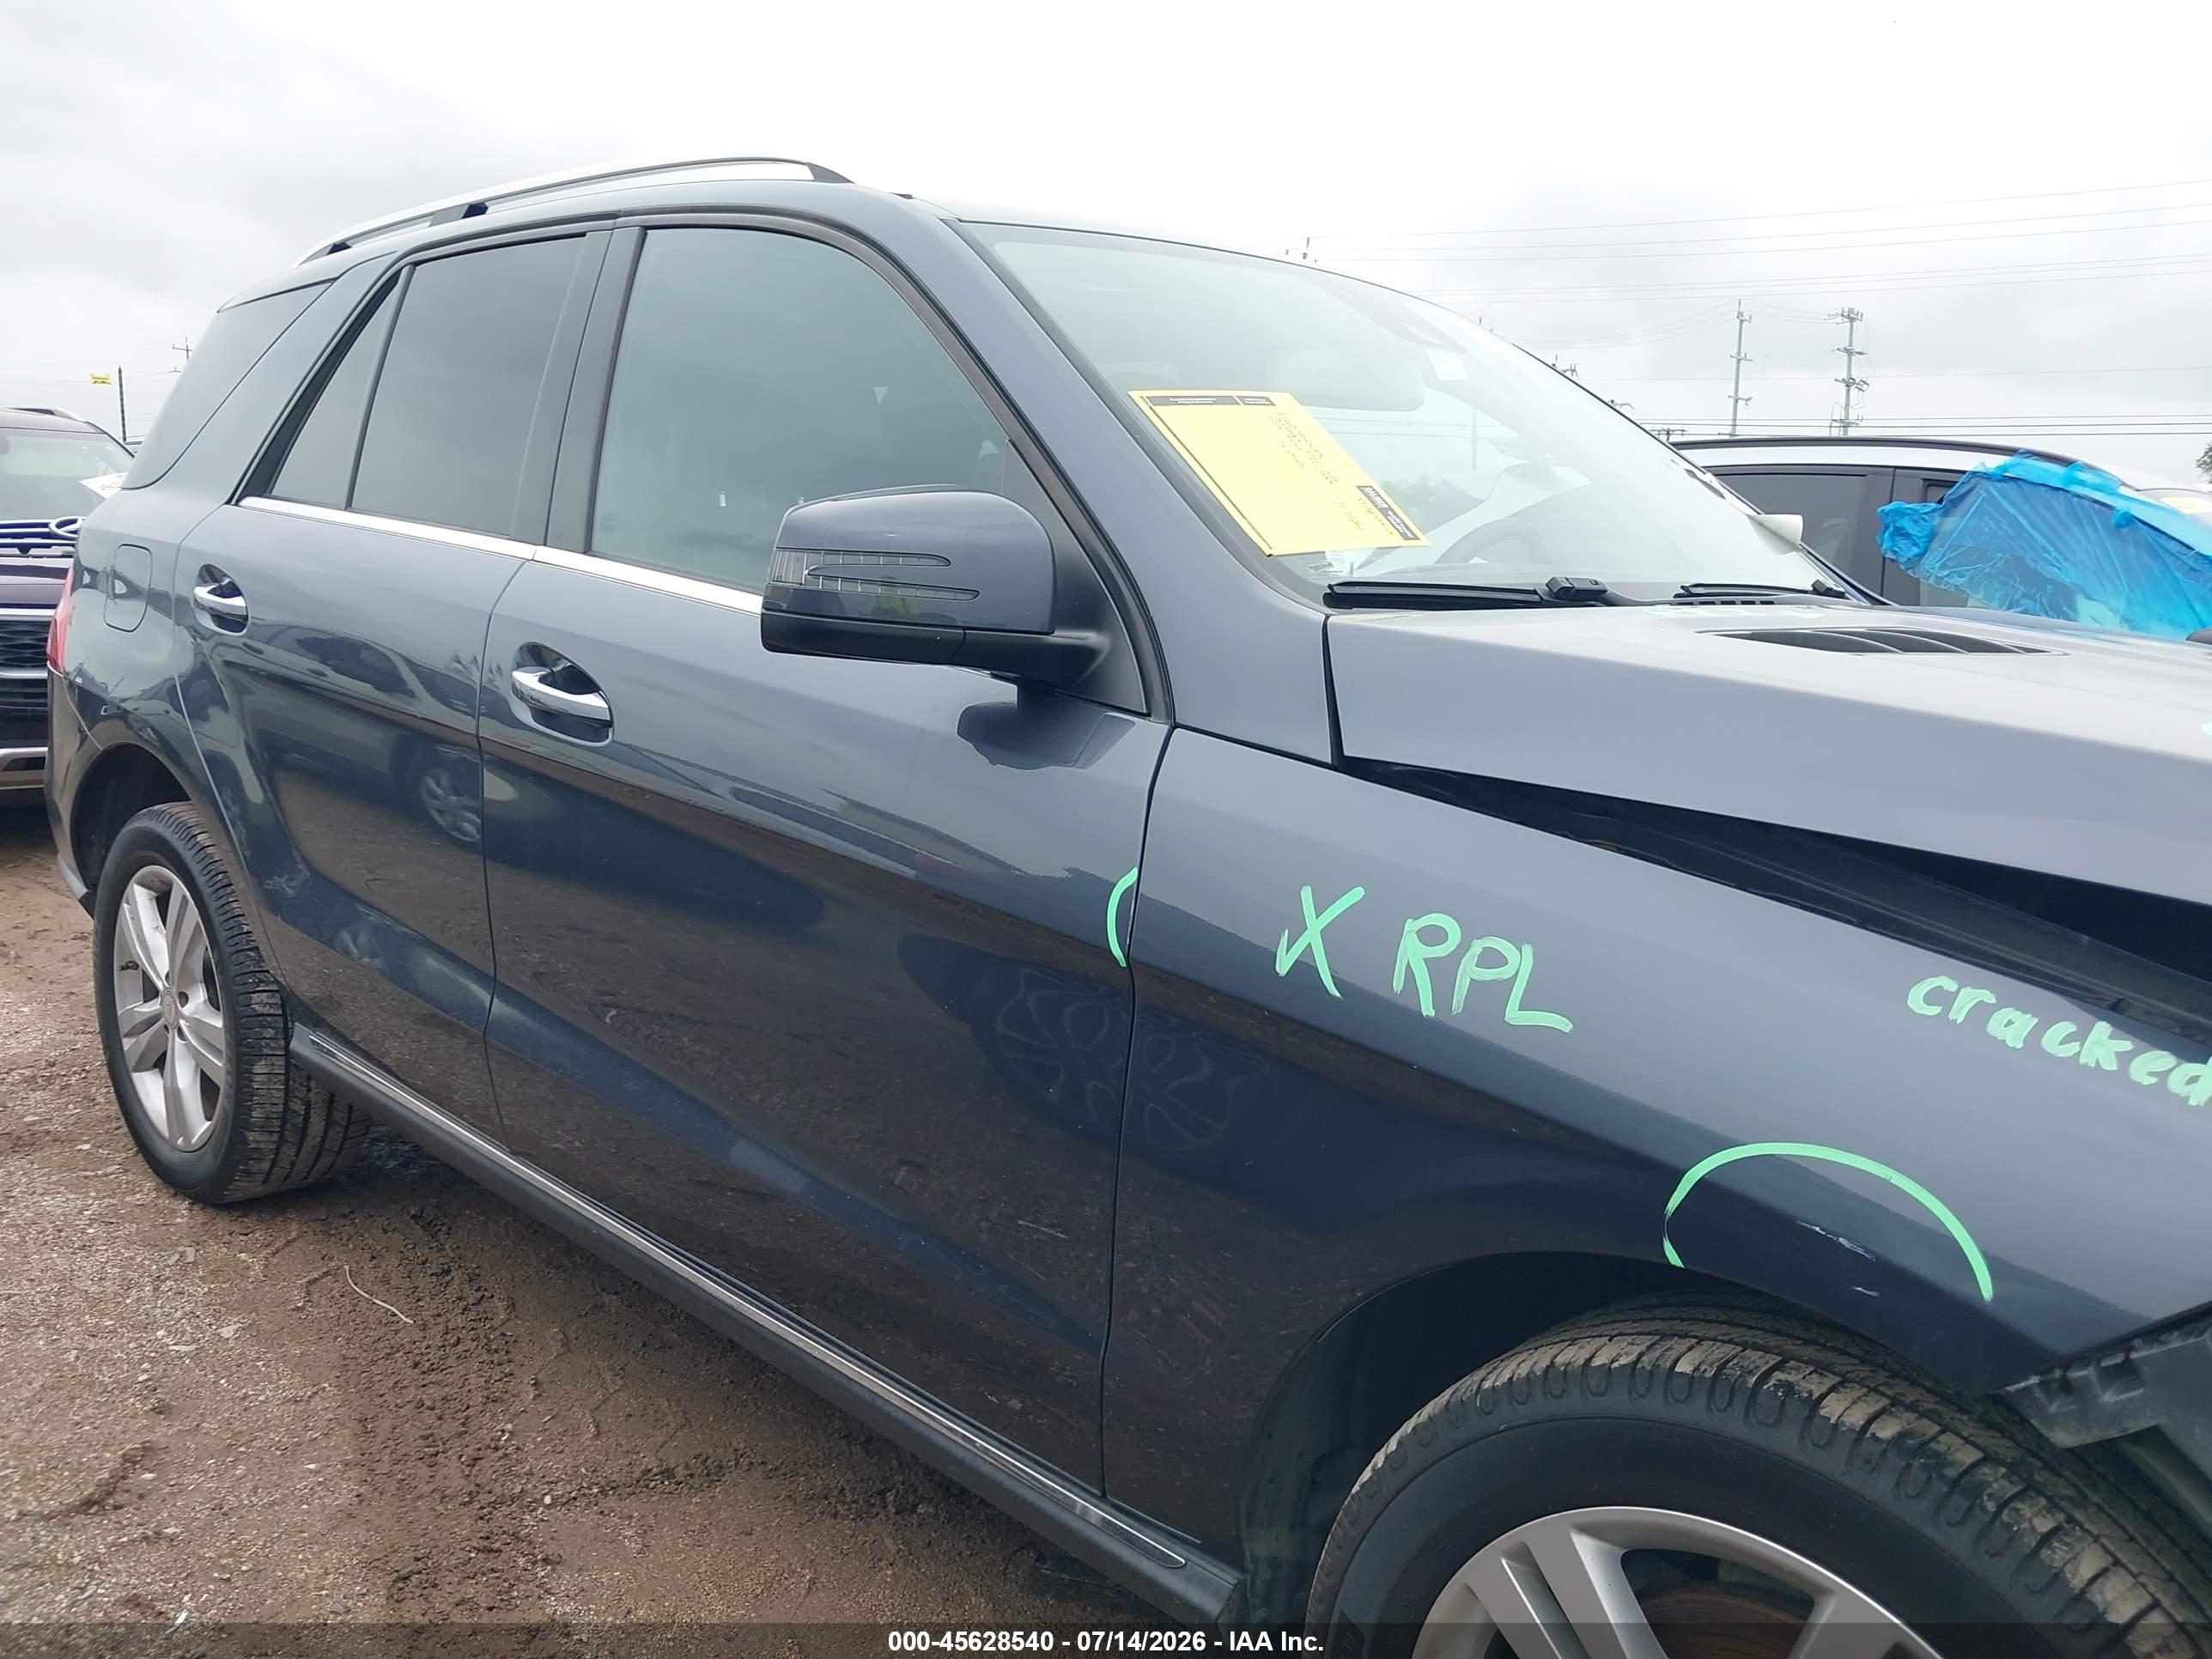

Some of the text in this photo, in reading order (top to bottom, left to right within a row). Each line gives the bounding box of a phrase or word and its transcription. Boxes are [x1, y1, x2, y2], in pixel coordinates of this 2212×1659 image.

[1276, 885, 1573, 1032] X RPL
[1907, 975, 2212, 1106] cracked
